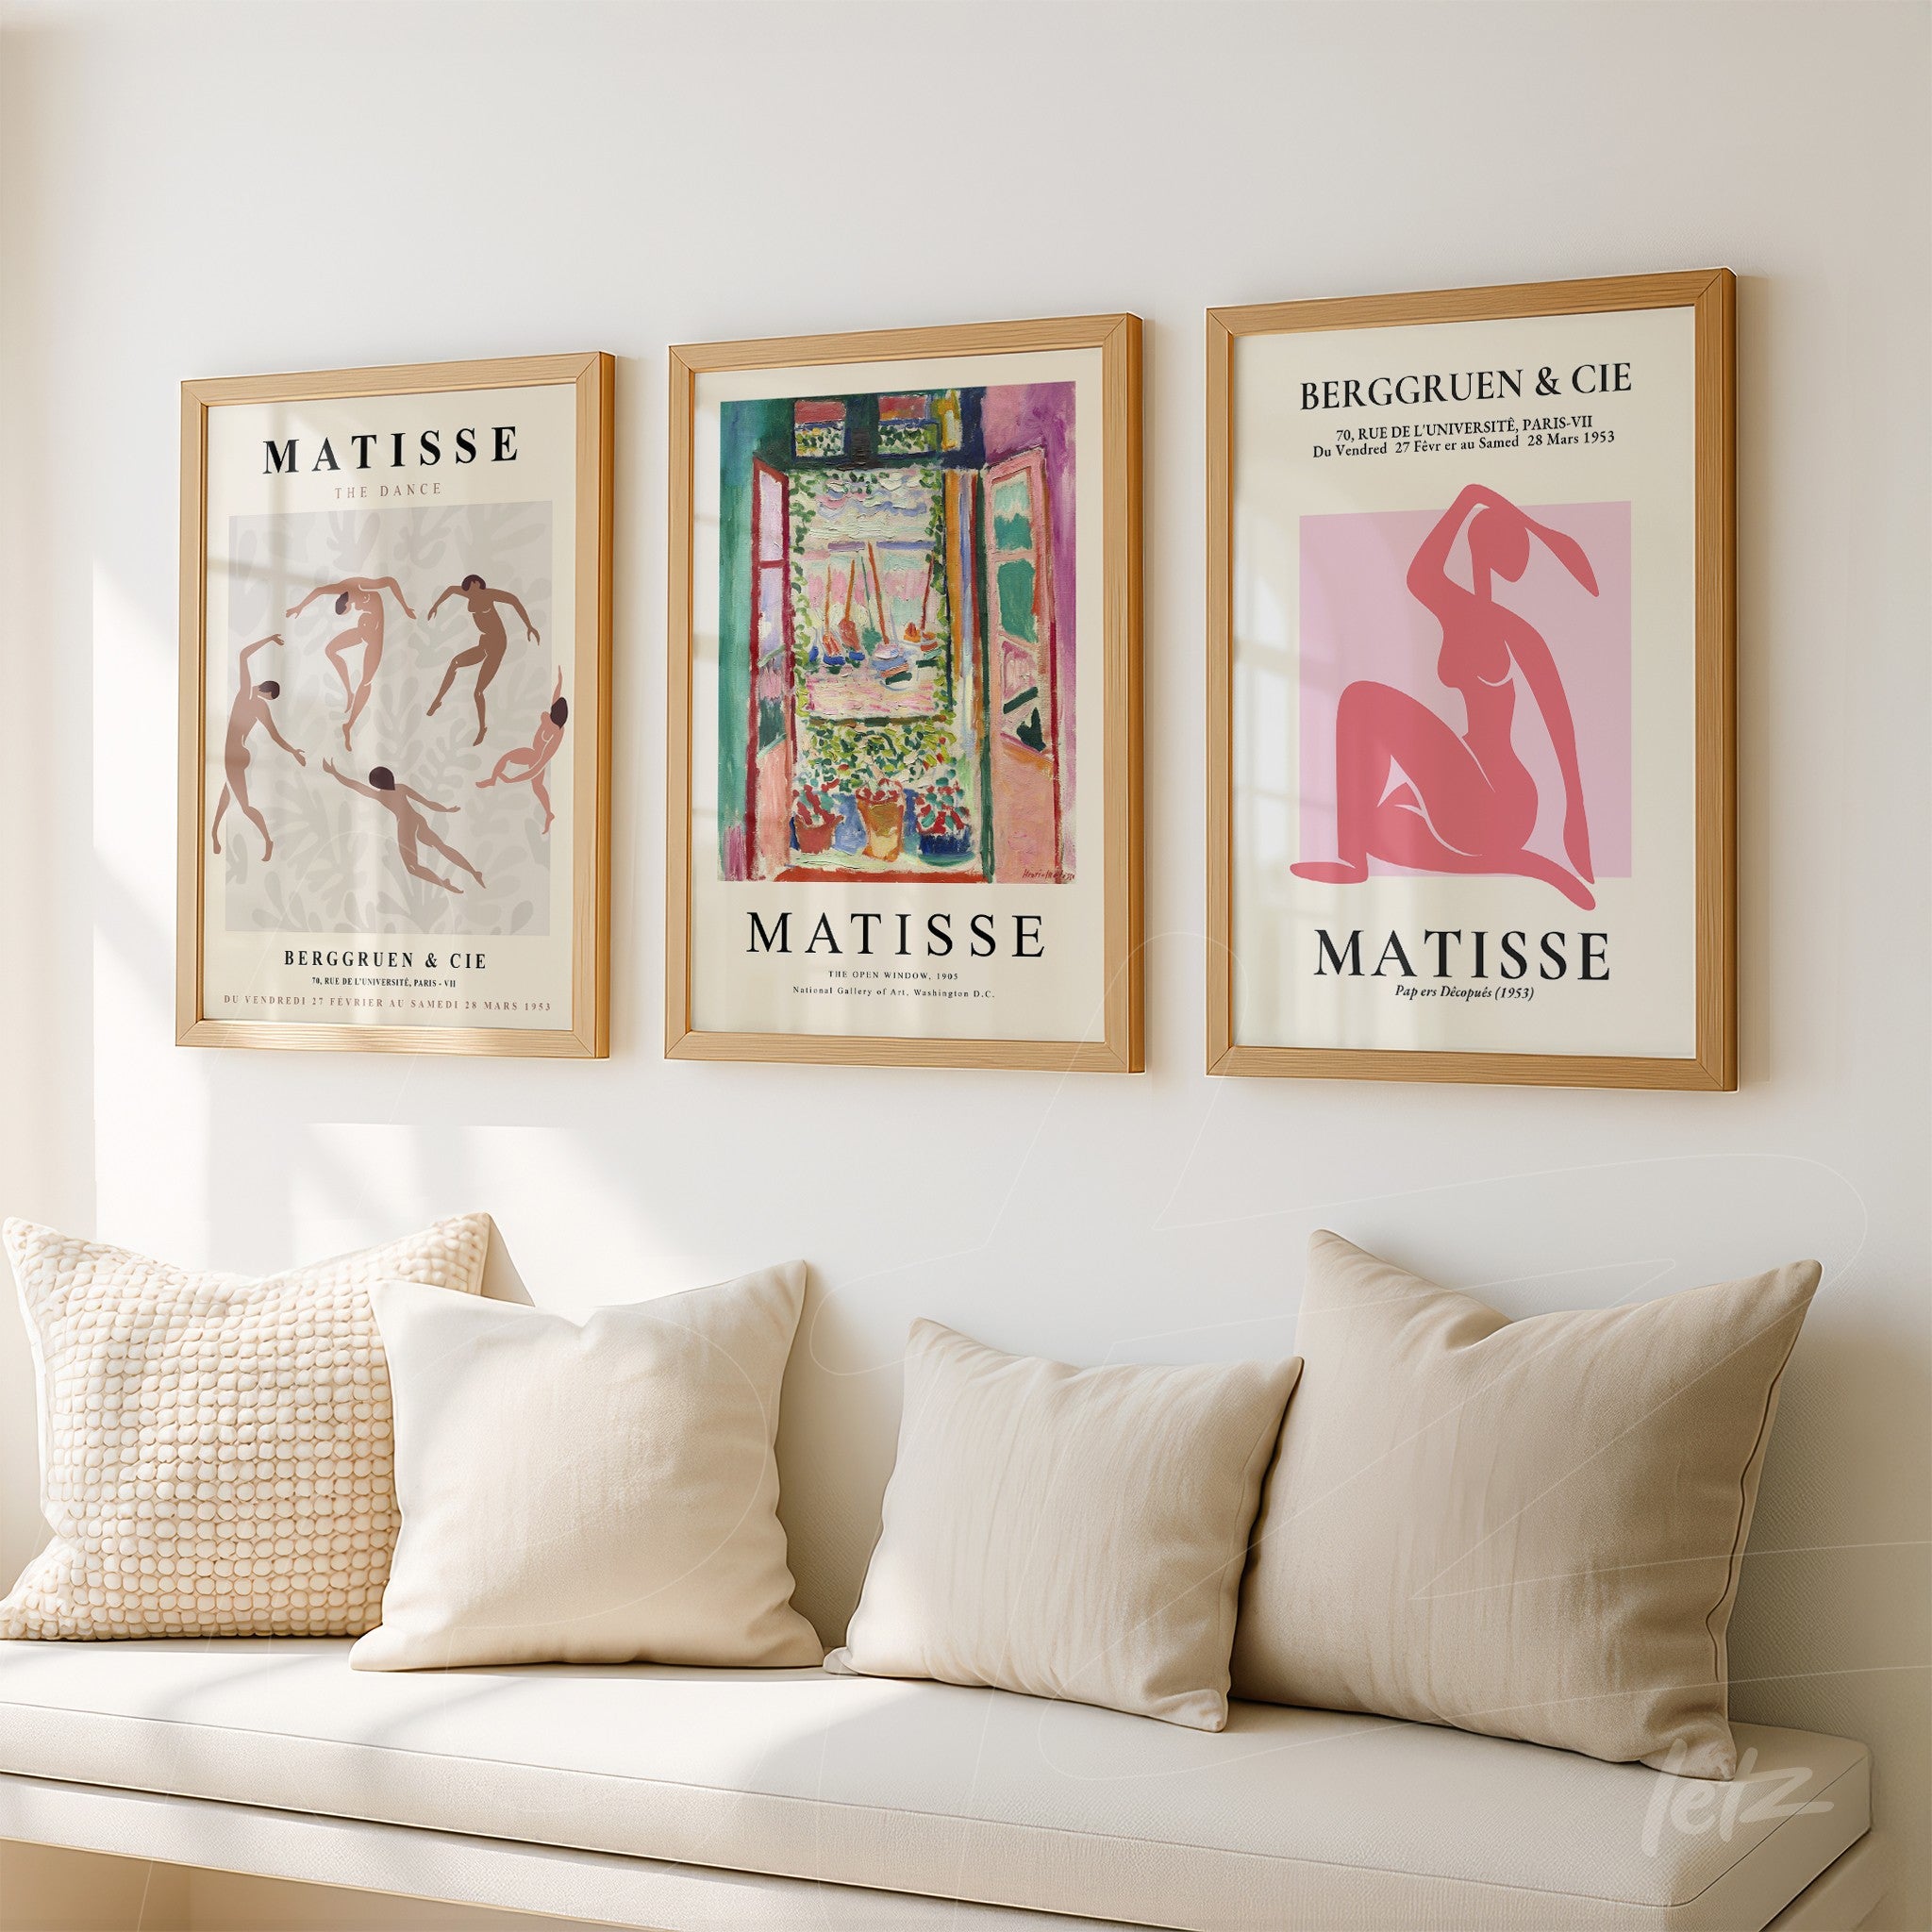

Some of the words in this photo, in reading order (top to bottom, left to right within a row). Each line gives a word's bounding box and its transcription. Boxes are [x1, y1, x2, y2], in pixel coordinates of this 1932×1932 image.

[1301, 369, 1524, 410] BERGGRUEN
[1535, 366, 1562, 396] &
[1572, 362, 1632, 394] CIE
[1336, 429, 1355, 443] 70,
[1357, 426, 1388, 441] RUE
[1391, 425, 1410, 439] DE
[1522, 415, 1593, 432] PARIS-VII
[262, 425, 518, 475] MATISSE
[1312, 445, 1332, 458] Du
[1335, 442, 1388, 457] Vendred
[1394, 441, 1410, 454] 27
[1460, 441, 1475, 450] au
[1478, 434, 1520, 449] Samed
[1527, 434, 1543, 447] 28
[1546, 432, 1579, 446] Mars
[1584, 430, 1615, 444] 1953
[334, 486, 368, 499] THE
[379, 482, 441, 497] DANCE
[745, 911, 1045, 958] MATISSE
[284, 950, 413, 968] BERGGRUEN
[425, 952, 438, 969] &
[449, 953, 486, 970] CIE
[1313, 928, 1610, 981] MATISSE
[311, 976, 323, 986] 70,
[324, 976, 340, 986] RUE
[341, 977, 353, 986] DE
[413, 978, 437, 988] PARIS
[443, 979, 456, 988] VII
[829, 970, 848, 978] THE
[852, 971, 879, 979] OPEN
[224, 994, 240, 1004] DU
[244, 995, 306, 1006] VENDREDI
[311, 996, 324, 1006] 27
[390, 999, 405, 1008] AU
[410, 999, 458, 1009] SAMEDI
[465, 1000, 477, 1010] 28
[483, 1001, 518, 1011] MARS
[525, 1002, 551, 1011] 1953
[792, 986, 833, 994] National
[837, 987, 873, 997] Gallery
[875, 987, 888, 996] of
[913, 989, 969, 999] Washington
[973, 990, 995, 998] D.C.
[1494, 986, 1535, 1002] (1953)
